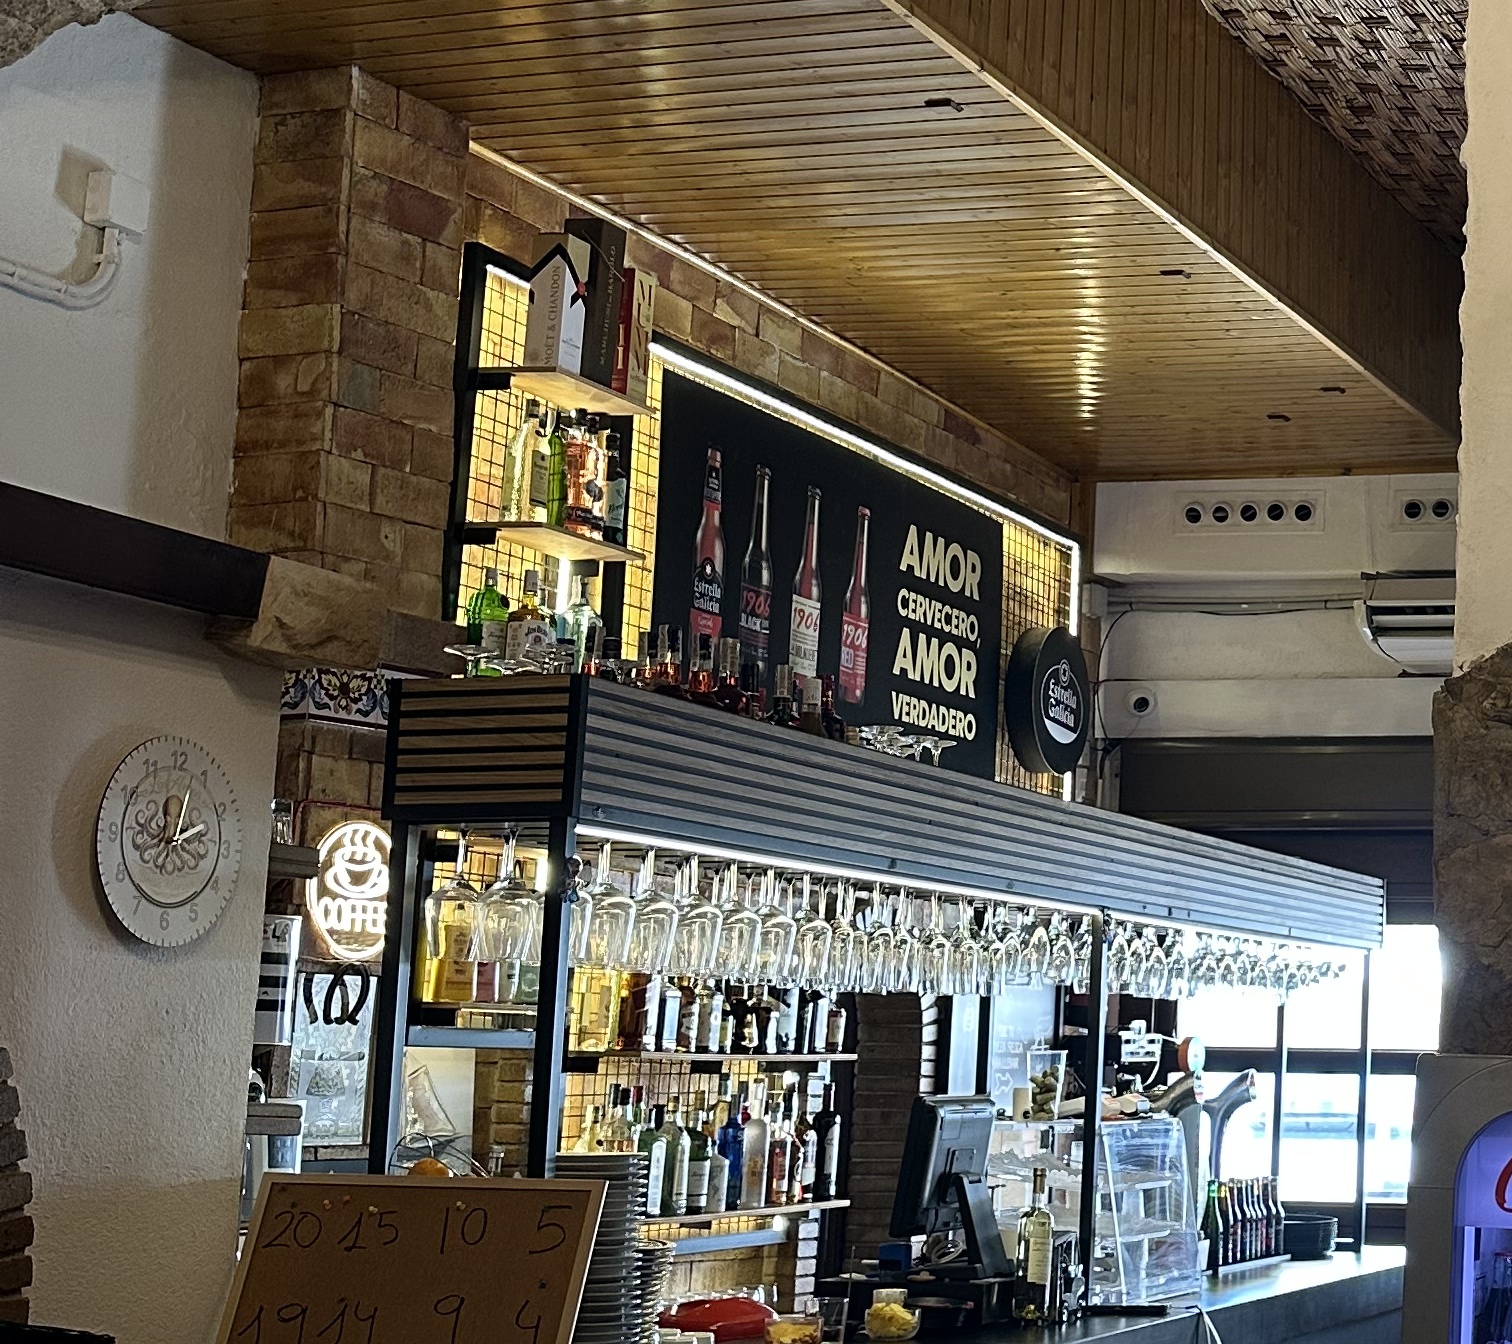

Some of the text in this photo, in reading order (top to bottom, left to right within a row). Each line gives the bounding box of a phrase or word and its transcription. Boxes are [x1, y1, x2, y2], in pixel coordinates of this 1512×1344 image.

[548, 265, 561, 322] CHANDON
[899, 524, 982, 602] AMOR
[693, 576, 721, 599] Estrella
[692, 593, 720, 614] Galicia
[743, 590, 771, 619] 1906
[793, 606, 820, 633] 1906
[897, 588, 982, 647] CERVECERO,
[843, 623, 868, 649] 1906
[892, 627, 977, 699] AMOR
[1048, 678, 1077, 709] Estrella
[891, 690, 977, 741] VERDADERO
[1048, 698, 1075, 727] Galicia
[142, 758, 160, 782] 11
[171, 750, 188, 772] 12
[108, 821, 119, 843] 9
[220, 840, 231, 860] 3
[115, 861, 126, 883] 8
[209, 875, 220, 895] 4
[132, 895, 143, 916] 7
[188, 903, 199, 923] 5
[159, 910, 170, 931] 6
[261, 1204, 574, 1256] 20 15 10 5
